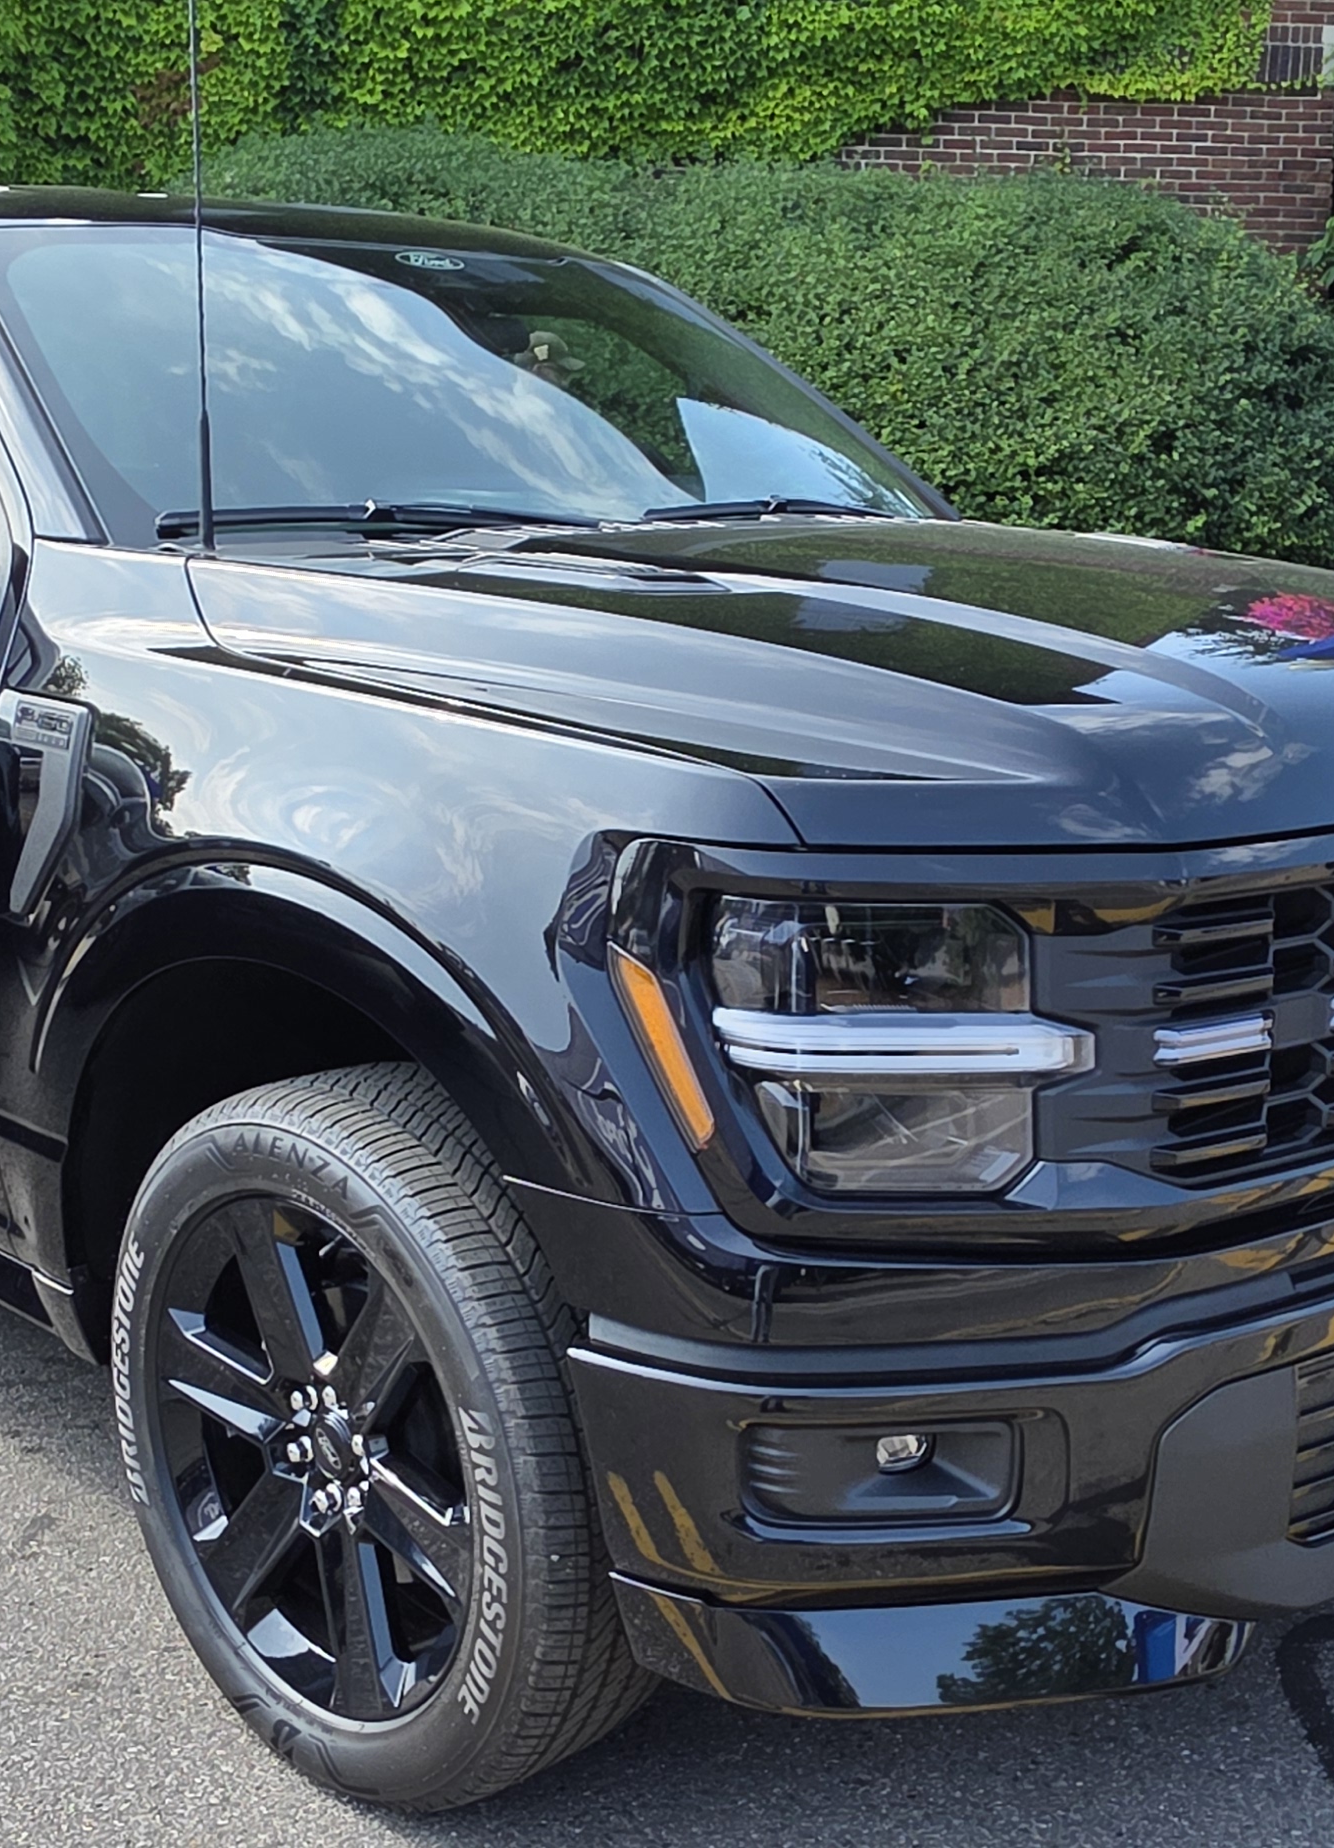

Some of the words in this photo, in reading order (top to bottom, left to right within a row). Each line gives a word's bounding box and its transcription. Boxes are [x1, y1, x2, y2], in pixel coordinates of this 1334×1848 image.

[234, 1132, 349, 1201] ALENZA
[113, 1232, 151, 1506] BRIDGESTONE
[458, 1406, 507, 1725] BRIDGESTONE
